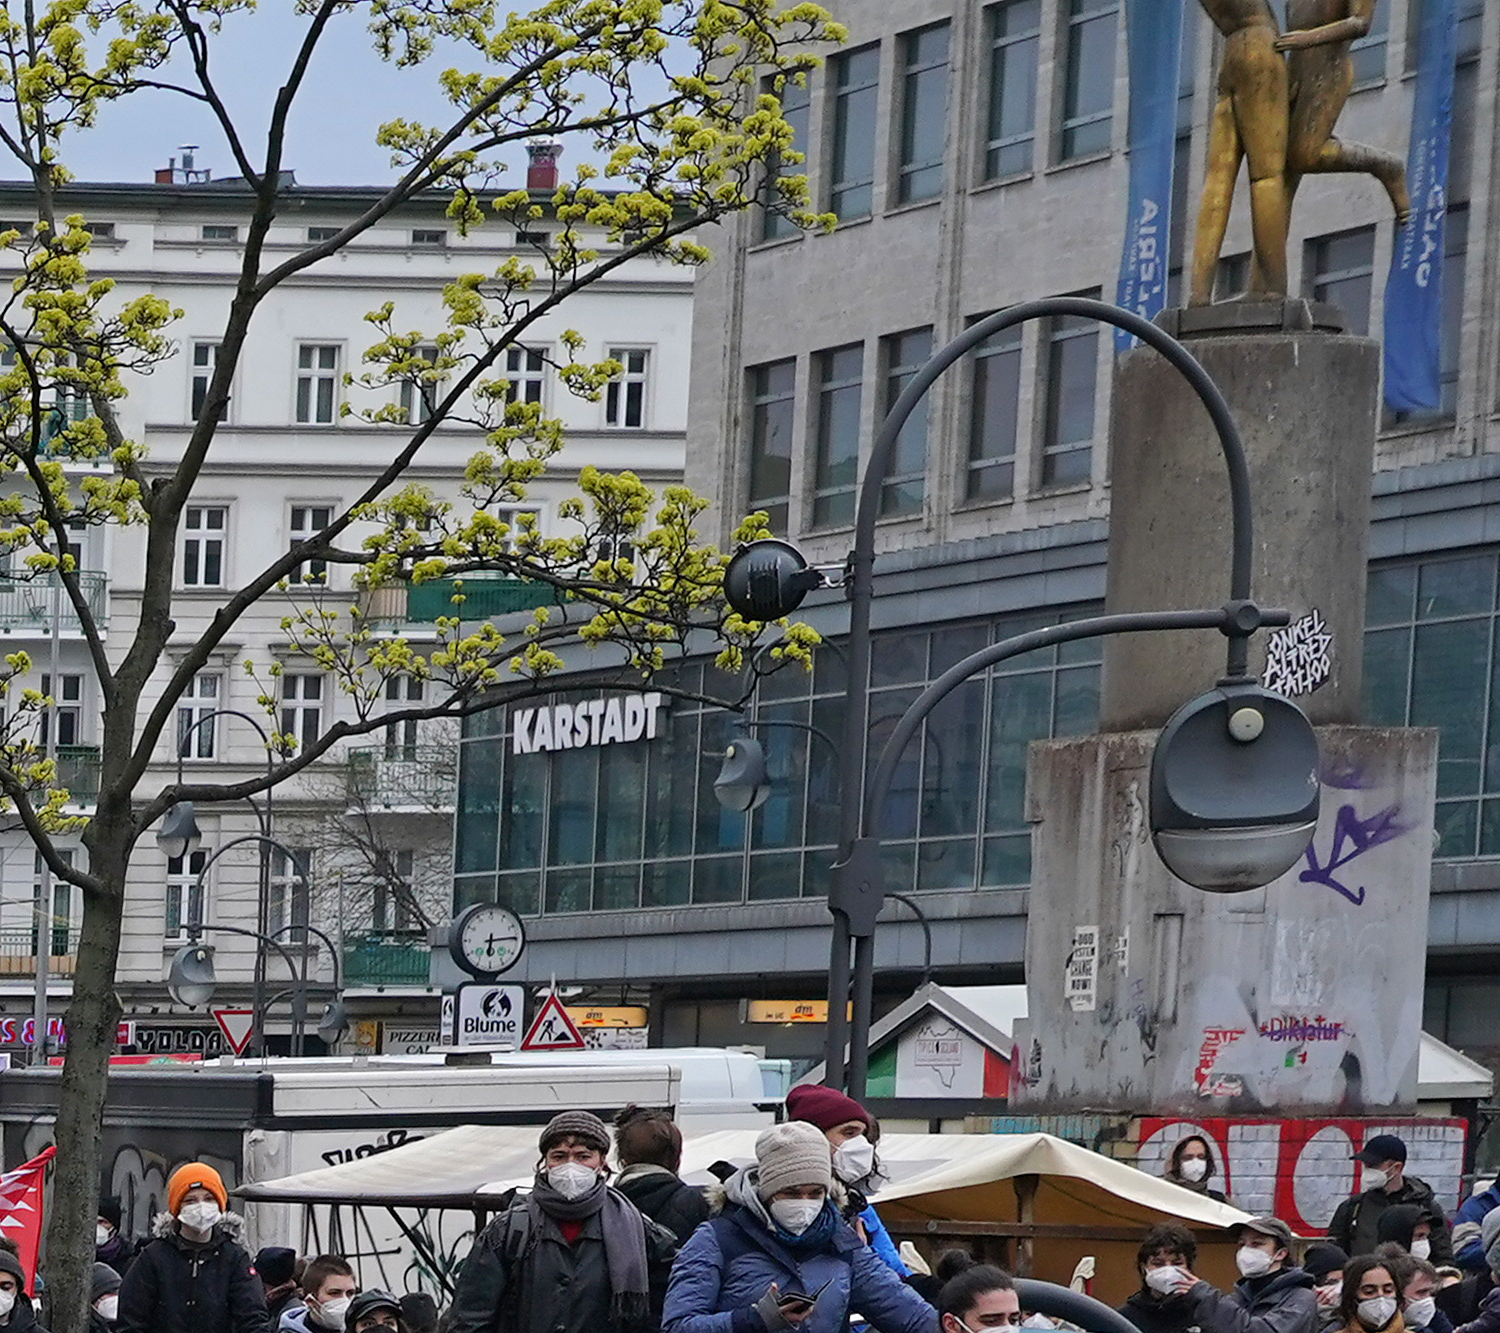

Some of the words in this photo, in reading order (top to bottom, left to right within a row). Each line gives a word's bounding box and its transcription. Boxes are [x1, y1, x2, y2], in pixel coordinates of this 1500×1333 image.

[1270, 608, 1326, 647] ONKEL
[513, 692, 661, 755] KARSTADT
[464, 1016, 517, 1034] Blume
